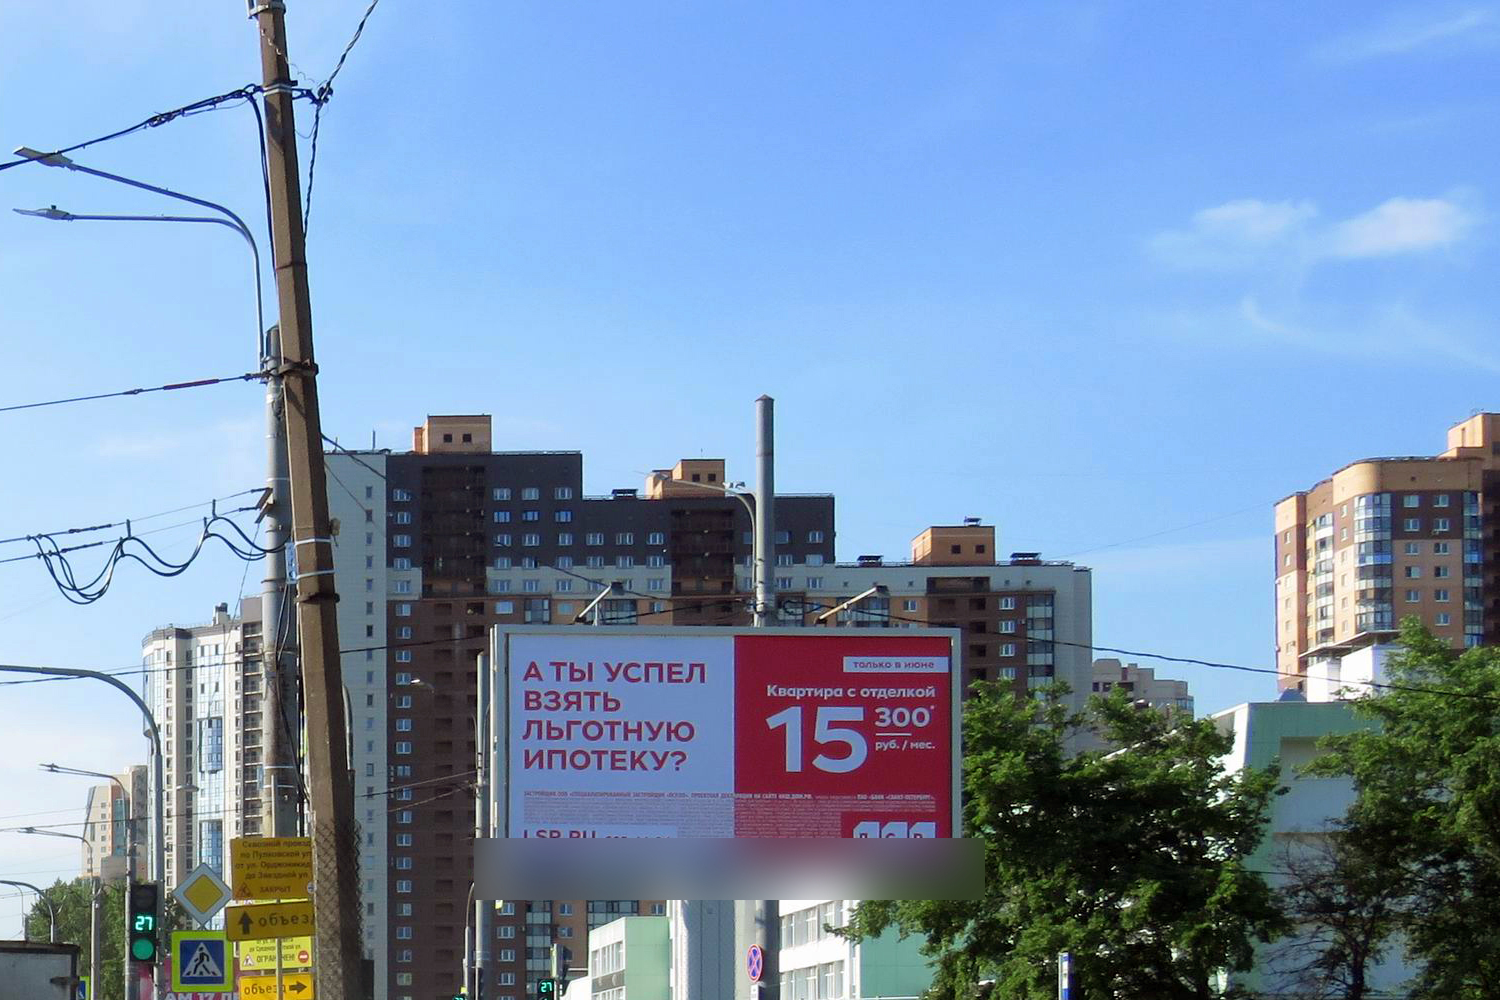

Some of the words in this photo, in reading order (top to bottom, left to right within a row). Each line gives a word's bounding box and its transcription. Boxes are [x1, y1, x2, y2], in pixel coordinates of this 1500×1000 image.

[522, 660, 544, 682] А
[549, 661, 594, 683] ТЫ
[603, 662, 706, 684] УСПЕЛ
[853, 661, 892, 669] только
[904, 661, 935, 669] июне
[523, 689, 622, 713] ВЗЯТЬ
[766, 684, 843, 700] Квартира
[847, 688, 856, 698] с
[860, 686, 936, 699] отделкой
[522, 719, 696, 743] ЛЬГОТНУЮ
[765, 705, 869, 774] 15
[875, 739, 900, 751] руб.
[910, 741, 936, 750] мес.
[523, 749, 688, 772] ИПОТЕКУ?
[135, 915, 153, 931] 27
[540, 981, 553, 993] 27
